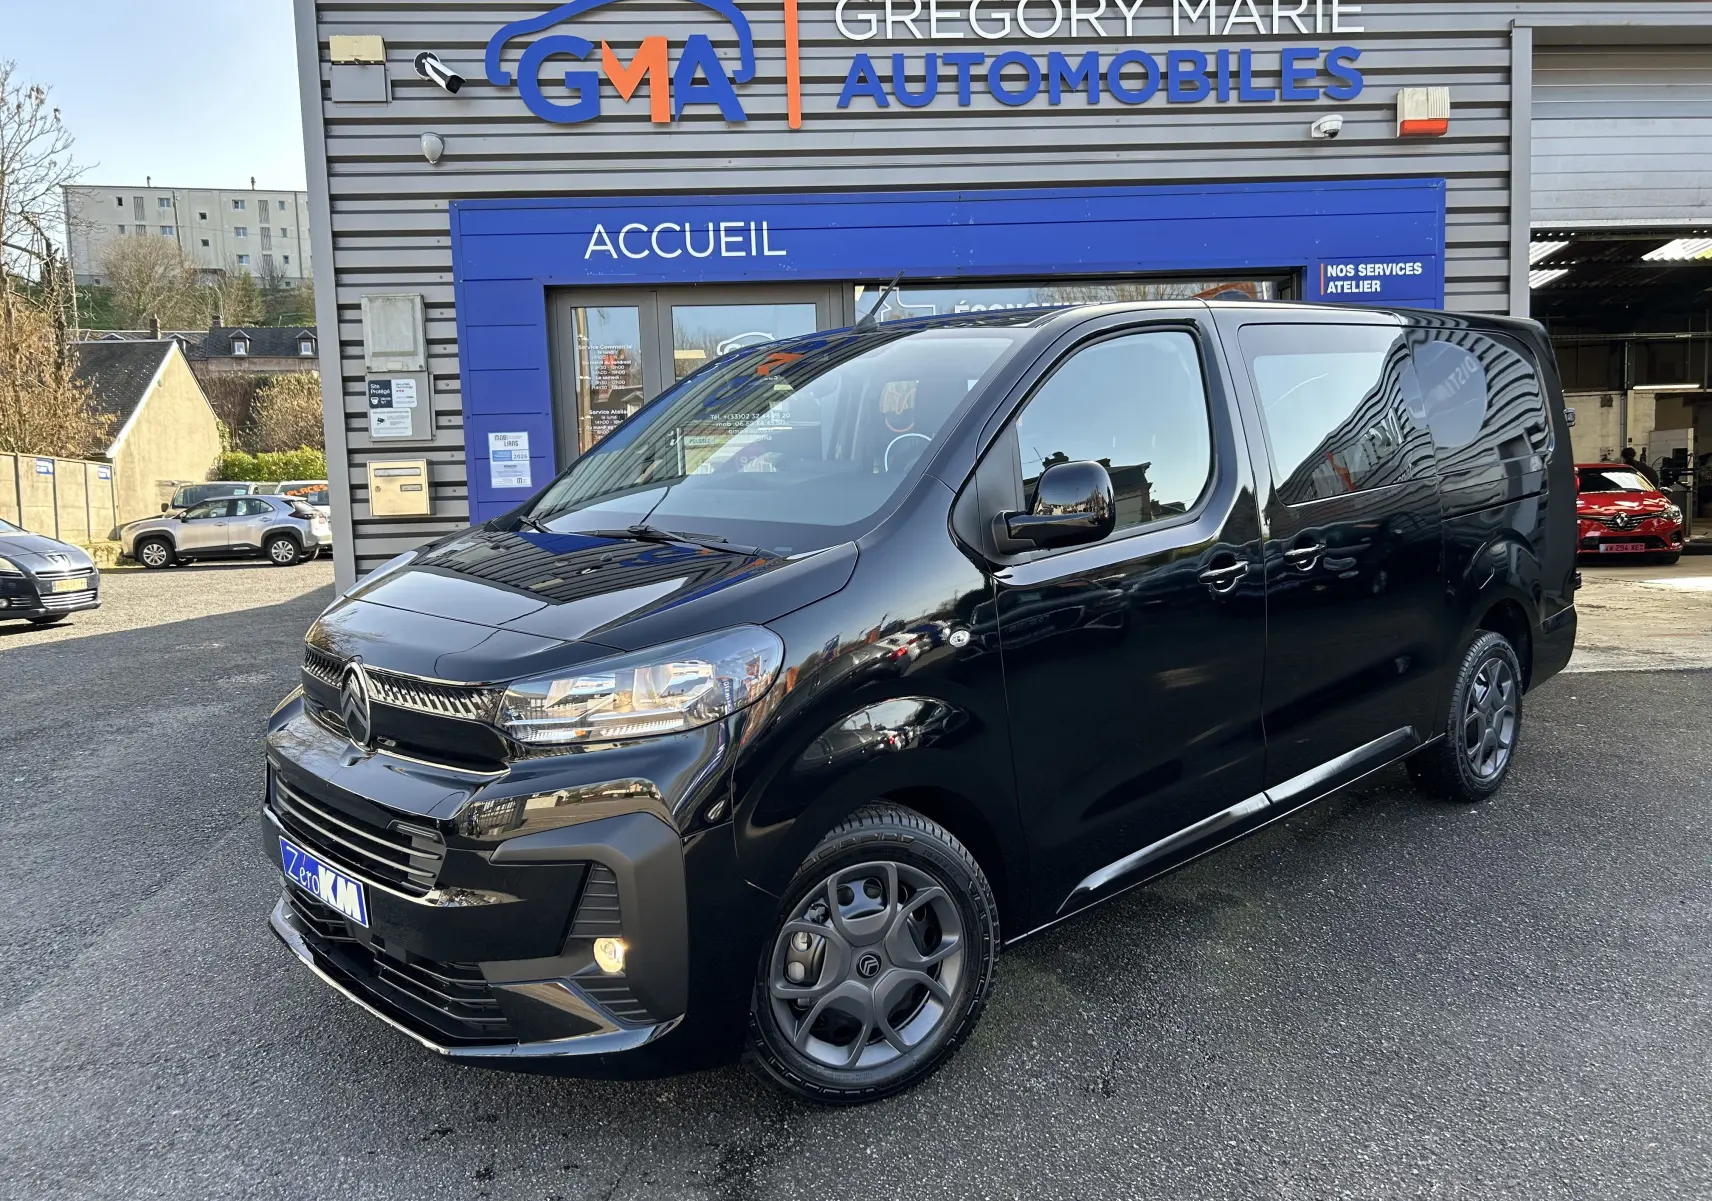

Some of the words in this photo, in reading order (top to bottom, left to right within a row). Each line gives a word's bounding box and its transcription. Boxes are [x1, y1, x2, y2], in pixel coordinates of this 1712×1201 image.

[1171, 0, 1365, 37] MARIE
[517, 34, 748, 123] GMA
[836, 46, 1364, 108] AUTOMOBILES
[584, 220, 787, 259] ACCUEIL
[1326, 264, 1355, 277] NOS
[1358, 262, 1423, 276] SERVICES
[1326, 280, 1381, 294] ATELIER
